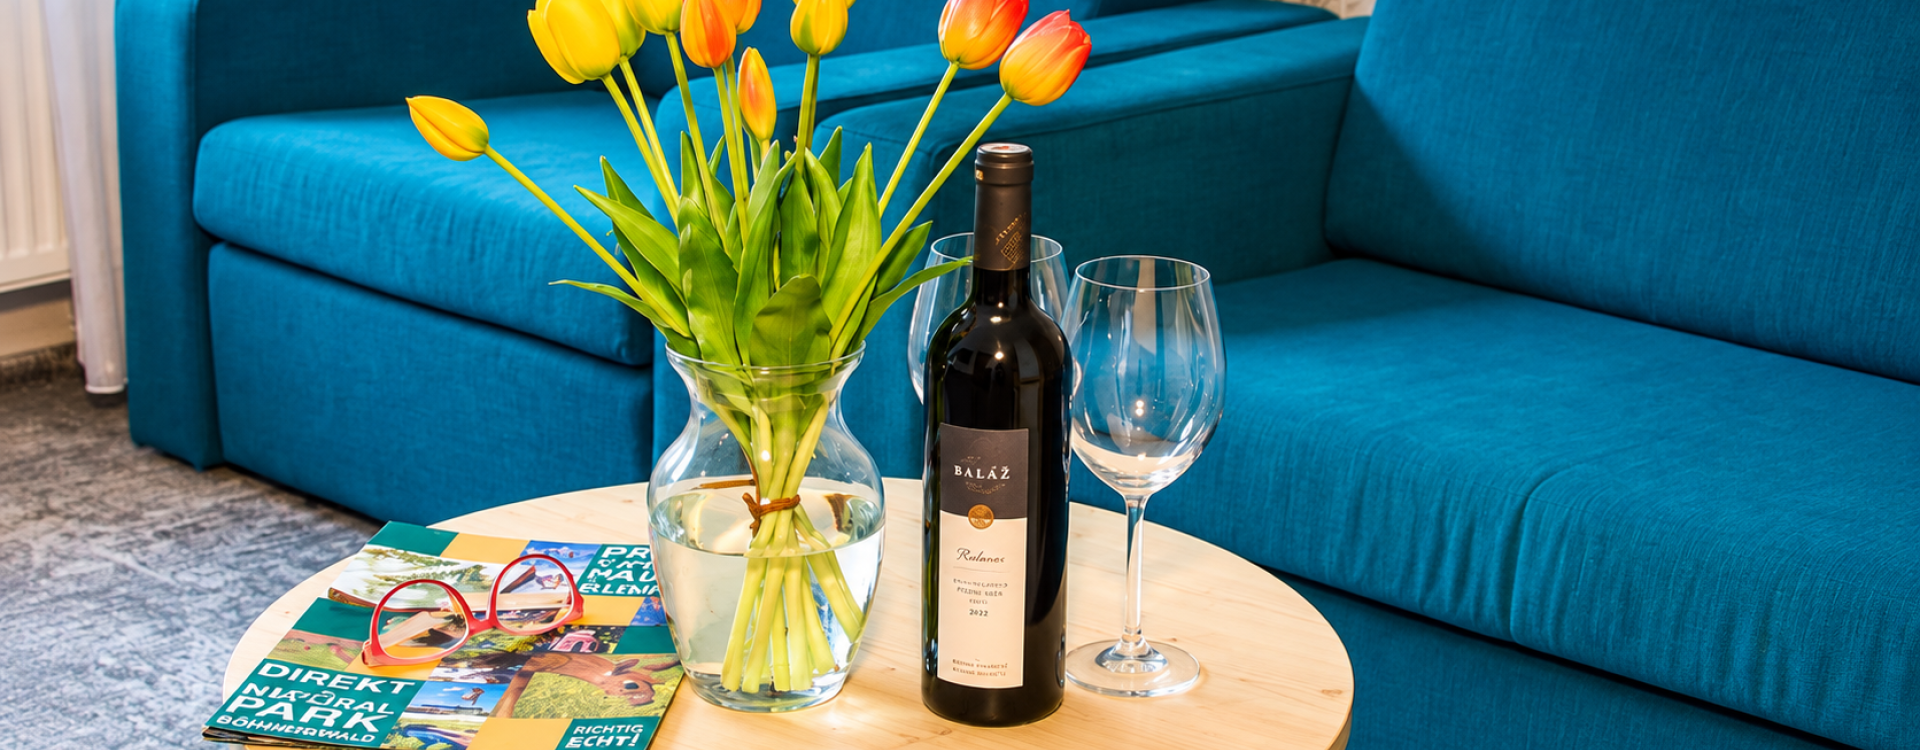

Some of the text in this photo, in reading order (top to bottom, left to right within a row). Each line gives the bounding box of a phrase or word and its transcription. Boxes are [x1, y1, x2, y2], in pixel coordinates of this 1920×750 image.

[954, 464, 1010, 480] BALÁŽ
[257, 662, 416, 695] DIREKT
[225, 695, 388, 733] PARK
[573, 724, 644, 735] RICHTIG
[564, 733, 640, 749] ECHT!
